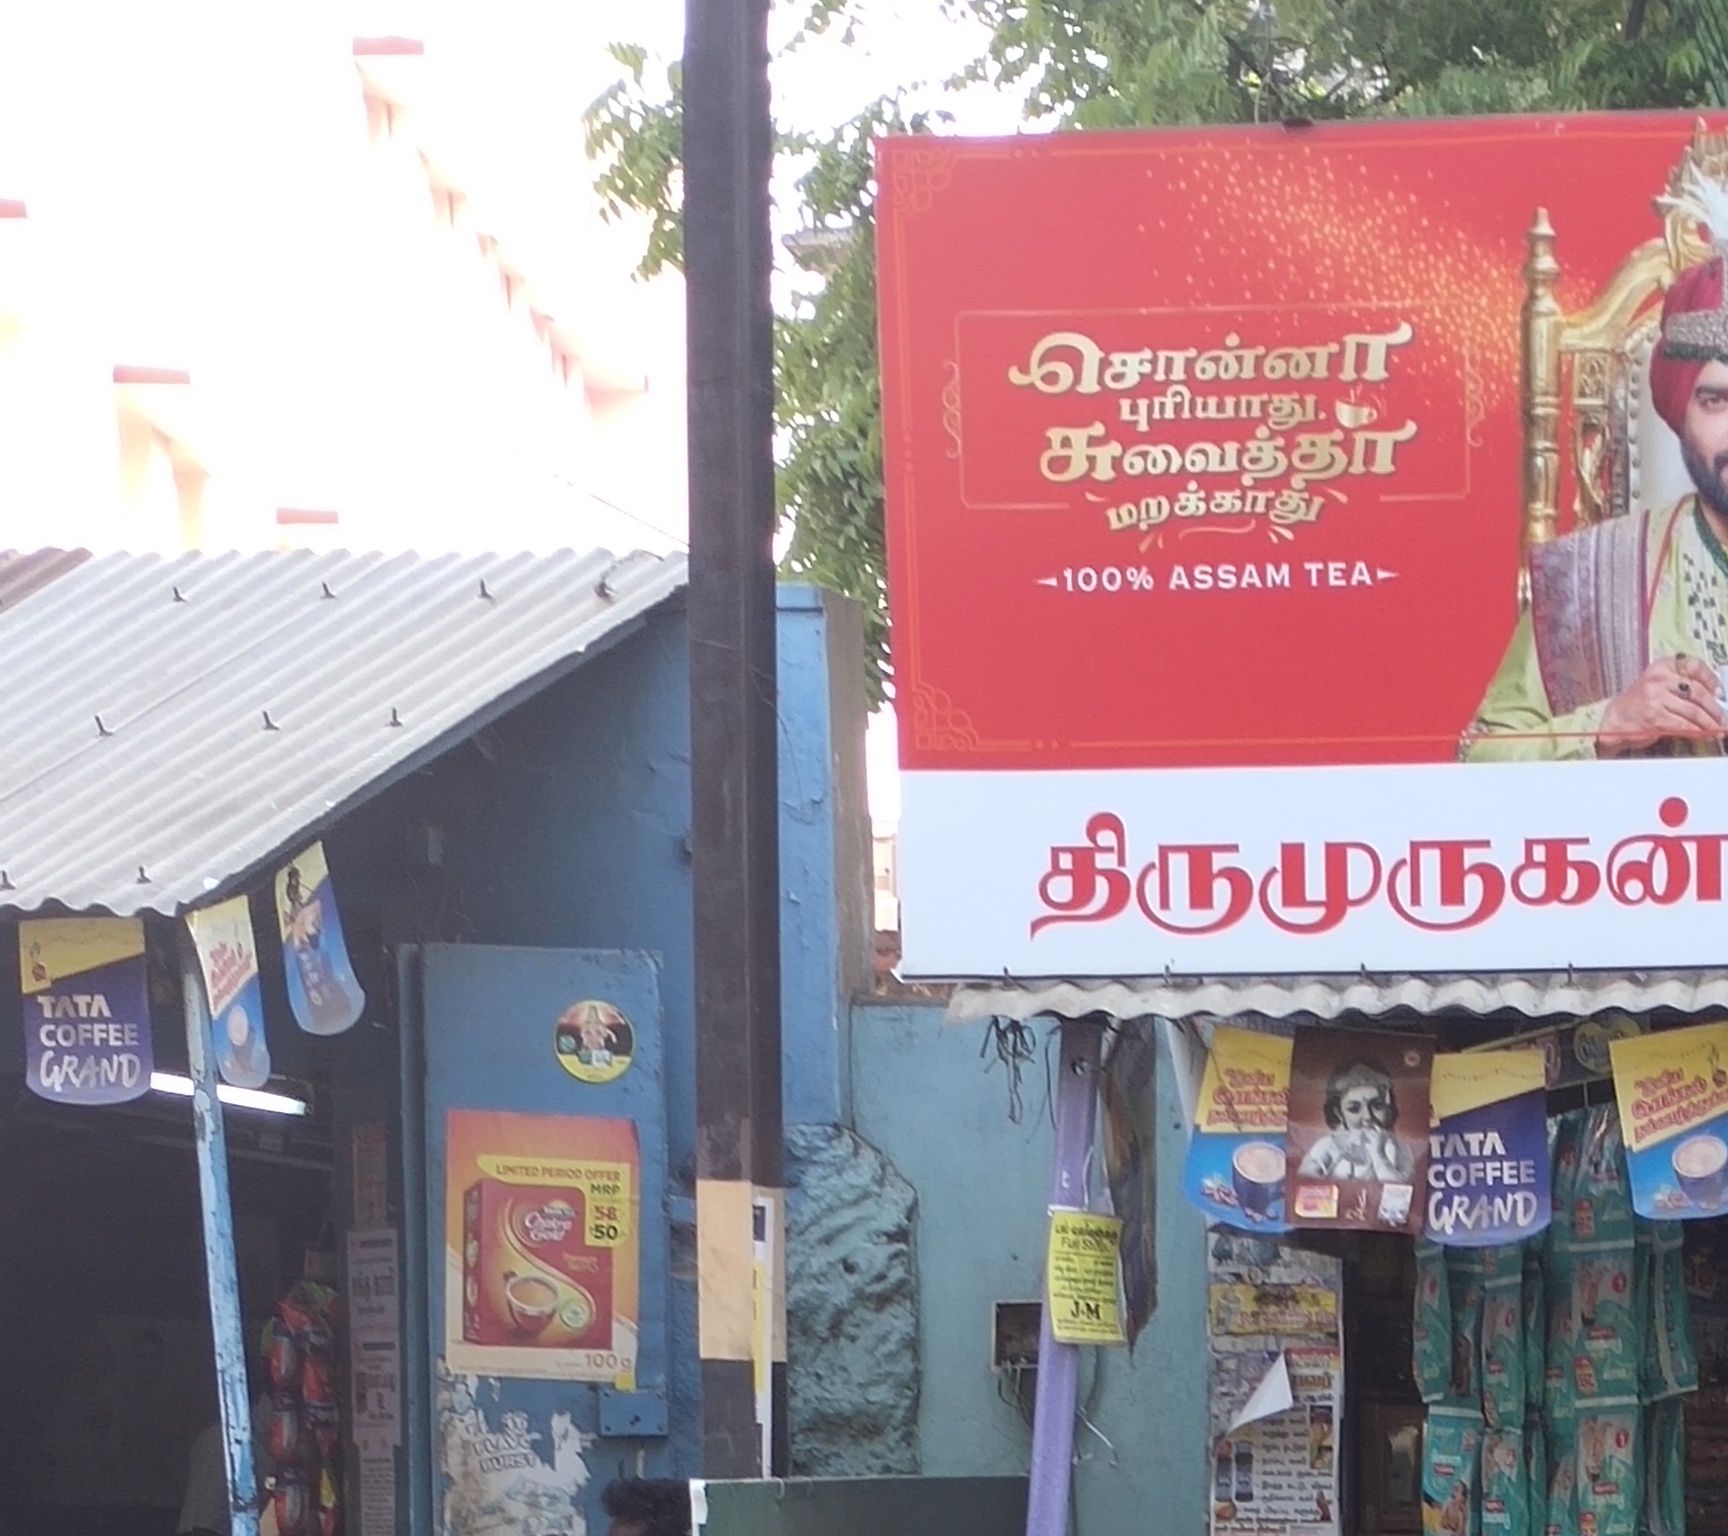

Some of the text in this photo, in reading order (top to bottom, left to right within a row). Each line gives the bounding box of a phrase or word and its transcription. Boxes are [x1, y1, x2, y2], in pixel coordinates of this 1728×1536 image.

[1009, 321, 1413, 394] சொன்னா
[1039, 420, 1418, 486] சுவைத்தா
[1105, 479, 1326, 531] மறக்காது
[1063, 561, 1373, 594] 100% ASSAM TEA
[37, 993, 112, 1019] TATA
[39, 1023, 140, 1049] COFFEE
[39, 1049, 142, 1093] GRAND
[1429, 1131, 1507, 1159] TATA
[496, 1163, 621, 1182] LIMITED PERIOD OFFER
[1427, 1160, 1536, 1189] COFFEE
[590, 1183, 621, 1196] MRP
[1428, 1190, 1538, 1236] GRAND
[585, 1353, 618, 1370] 100
